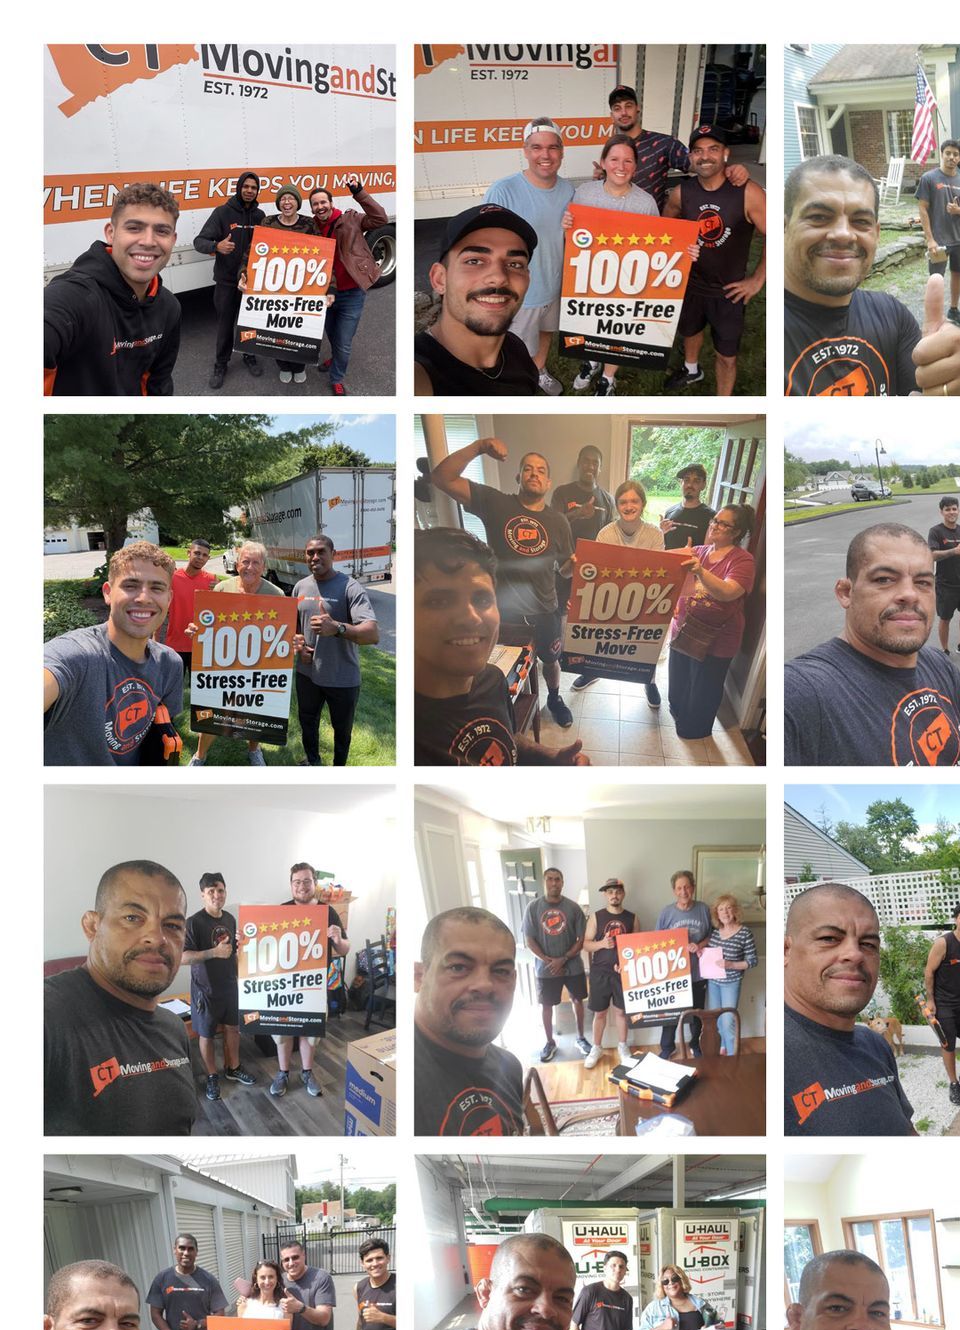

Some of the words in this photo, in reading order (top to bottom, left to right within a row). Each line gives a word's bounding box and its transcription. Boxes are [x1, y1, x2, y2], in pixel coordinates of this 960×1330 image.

[470, 71, 497, 80] EST.
[502, 70, 528, 80] 1972
[204, 80, 235, 96] EST.
[239, 84, 268, 99] 1972
[432, 127, 477, 145] LIFE
[812, 345, 836, 364] EST.
[837, 344, 859, 356] 1972
[576, 582, 675, 620] 100%
[572, 625, 663, 640] Stress-Free
[198, 625, 289, 667] 100%
[595, 642, 637, 655] Move
[197, 672, 287, 689] Stress-Free
[222, 691, 264, 707] Move
[125, 708, 143, 722] CT
[904, 700, 921, 717] EST.
[926, 728, 943, 752] CT
[243, 930, 322, 974] 100%
[243, 973, 322, 994] Stress-Free
[267, 993, 304, 1008] Move
[97, 1066, 115, 1082] CT
[459, 1095, 477, 1111] EST.
[802, 1092, 818, 1108] CT
[575, 1225, 628, 1236] U-HAUL
[684, 1255, 730, 1268] U-BOX
